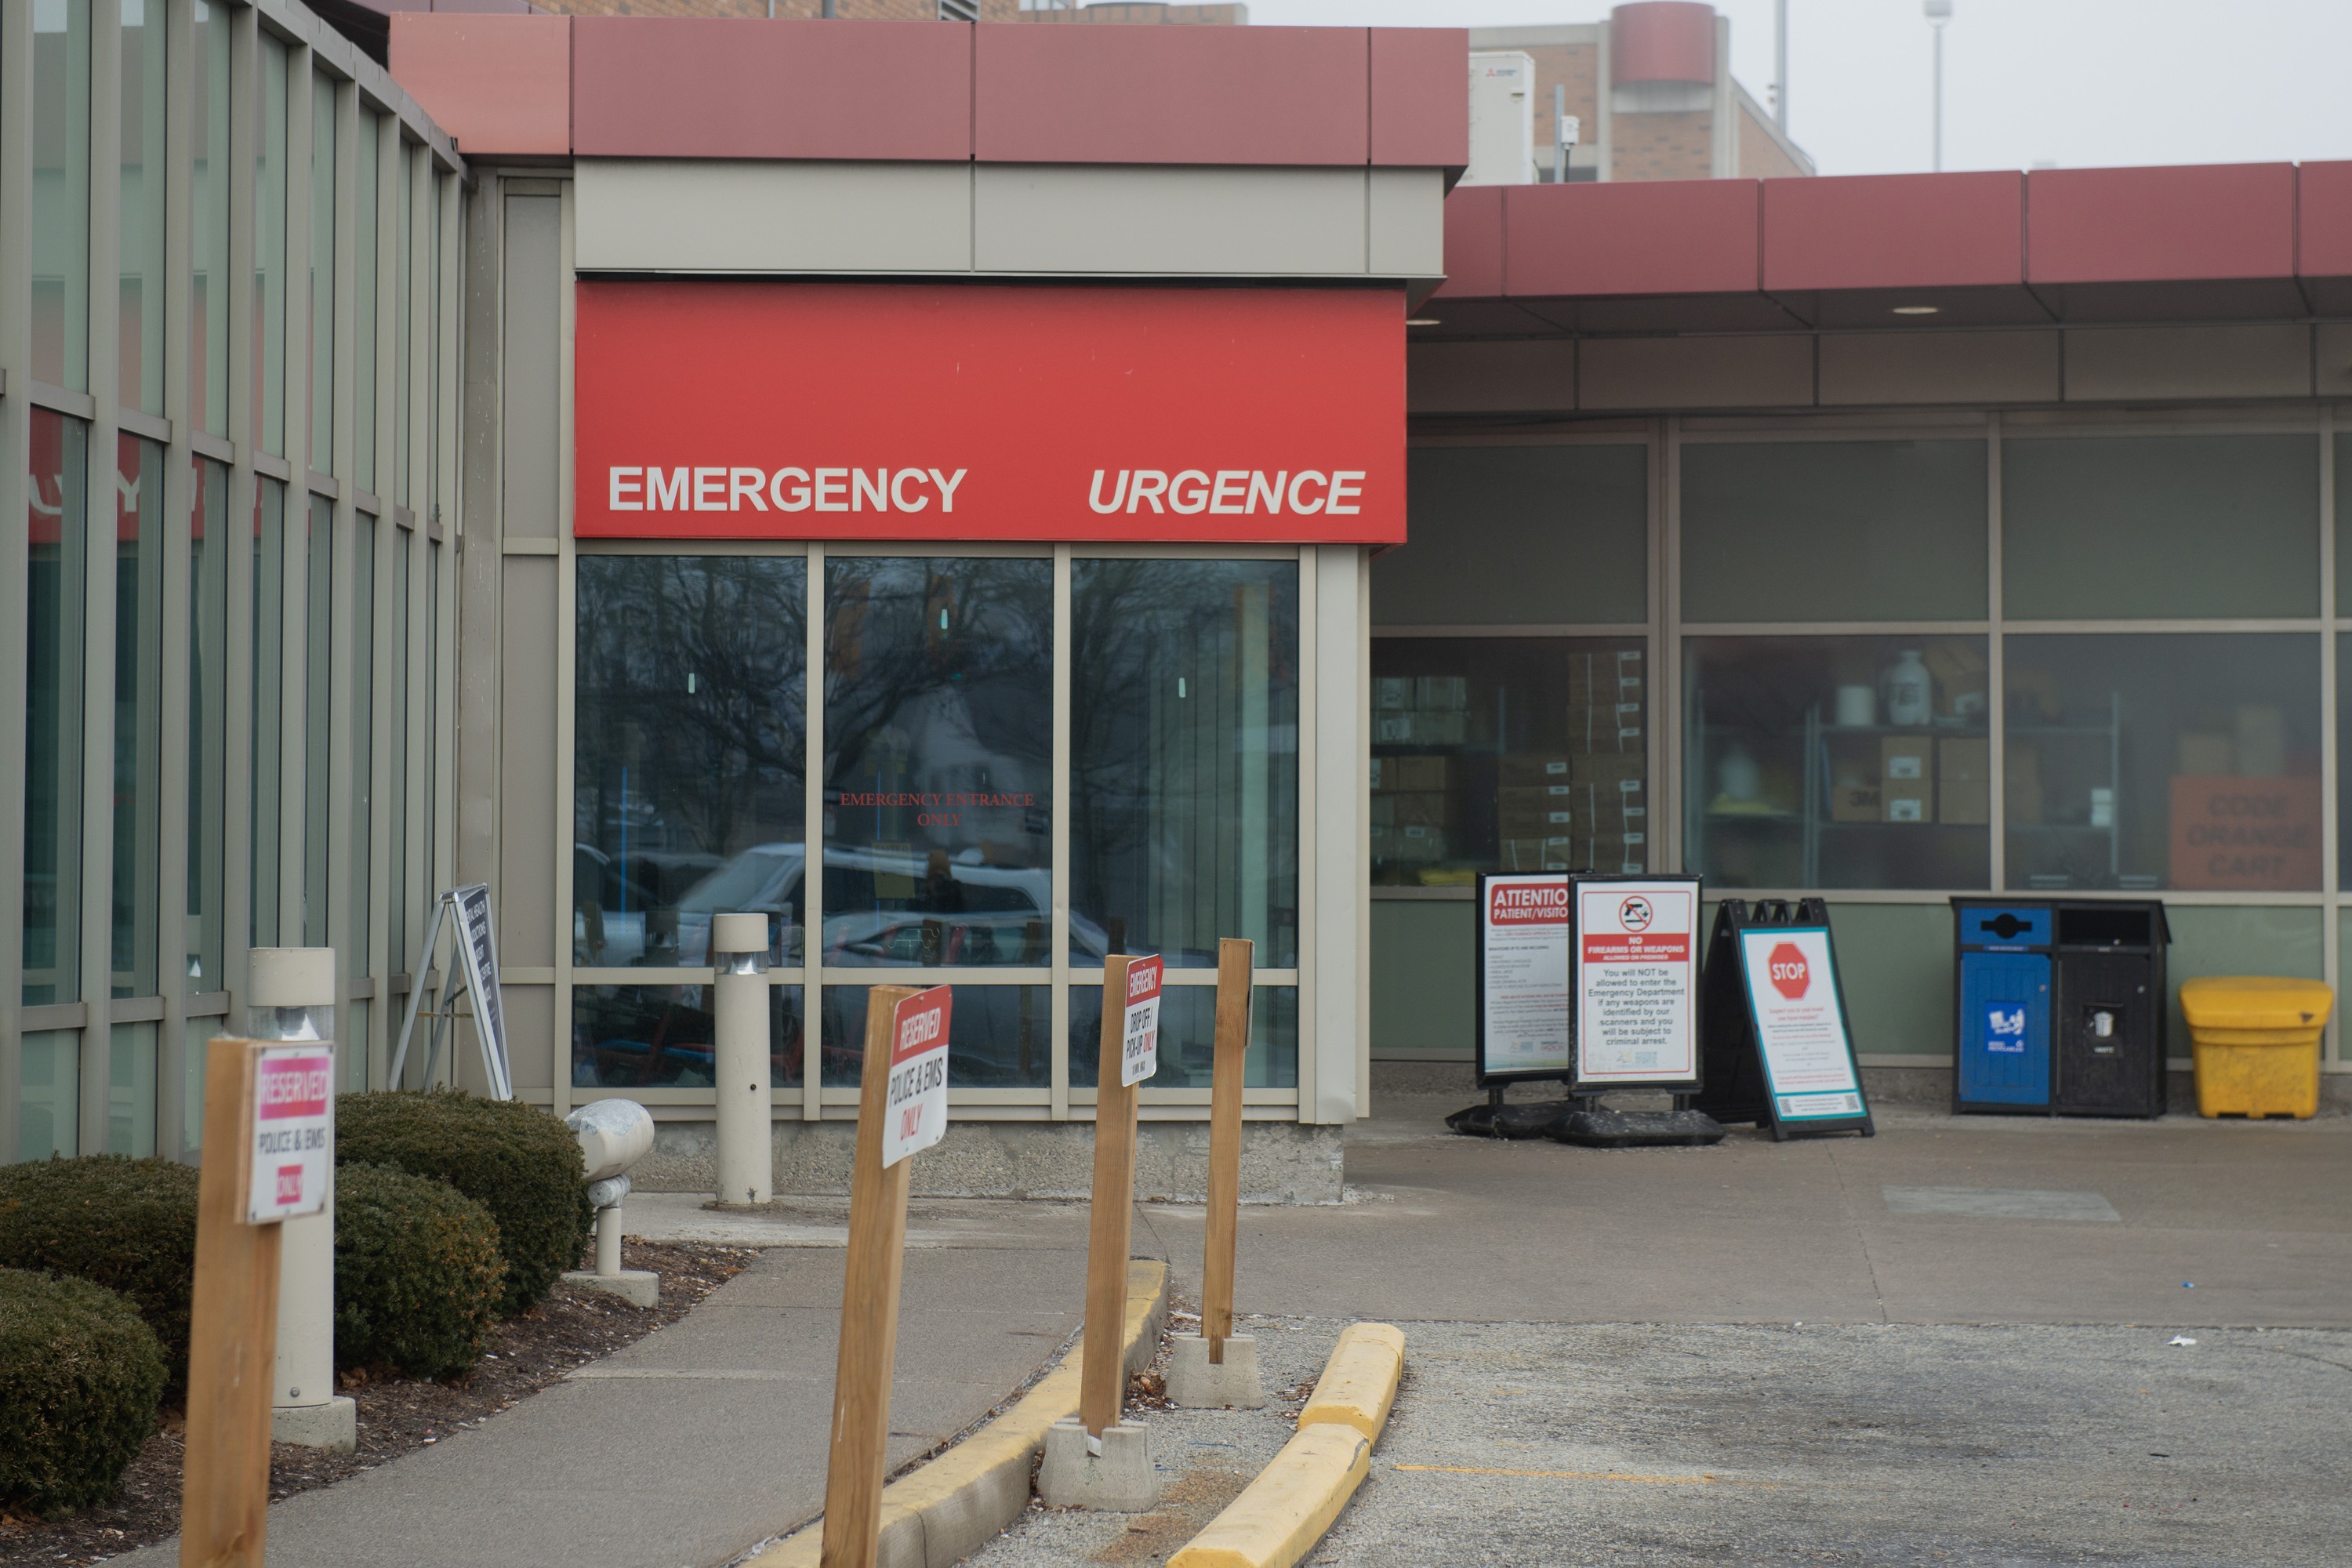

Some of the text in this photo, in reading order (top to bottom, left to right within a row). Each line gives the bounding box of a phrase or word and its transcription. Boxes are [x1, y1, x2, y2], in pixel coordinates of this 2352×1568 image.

[609, 466, 967, 514] EMERGENCY
[1088, 469, 1367, 515] URGENCE
[840, 793, 1035, 807] EMERGENCY ENTRANCE
[916, 813, 963, 827] ONLY
[1494, 887, 1569, 907] ATTENTIO
[1494, 906, 1569, 920] PATIENT/VISITO
[1588, 946, 1628, 954] FIREARMS
[1643, 945, 1685, 953] WEAPONS
[1628, 936, 1643, 945] NO
[1130, 966, 1157, 997] EMERGENCY
[1603, 968, 1619, 977] You
[1772, 962, 1806, 980] STOP
[1588, 988, 1685, 998] Emergency Department
[1131, 1011, 1142, 1033] DROP
[1643, 1008, 1653, 1017] by
[900, 1007, 941, 1051] RESERVED
[1631, 1028, 1661, 1036] subject
[1127, 1029, 1155, 1060] PICK-UP ONLY
[260, 1071, 328, 1104] RESERVED
[890, 1057, 943, 1108] POLICE & EMS
[900, 1103, 924, 1141] ONLY
[259, 1127, 326, 1154] POLICE & EMS
[278, 1174, 303, 1197] ONLY
